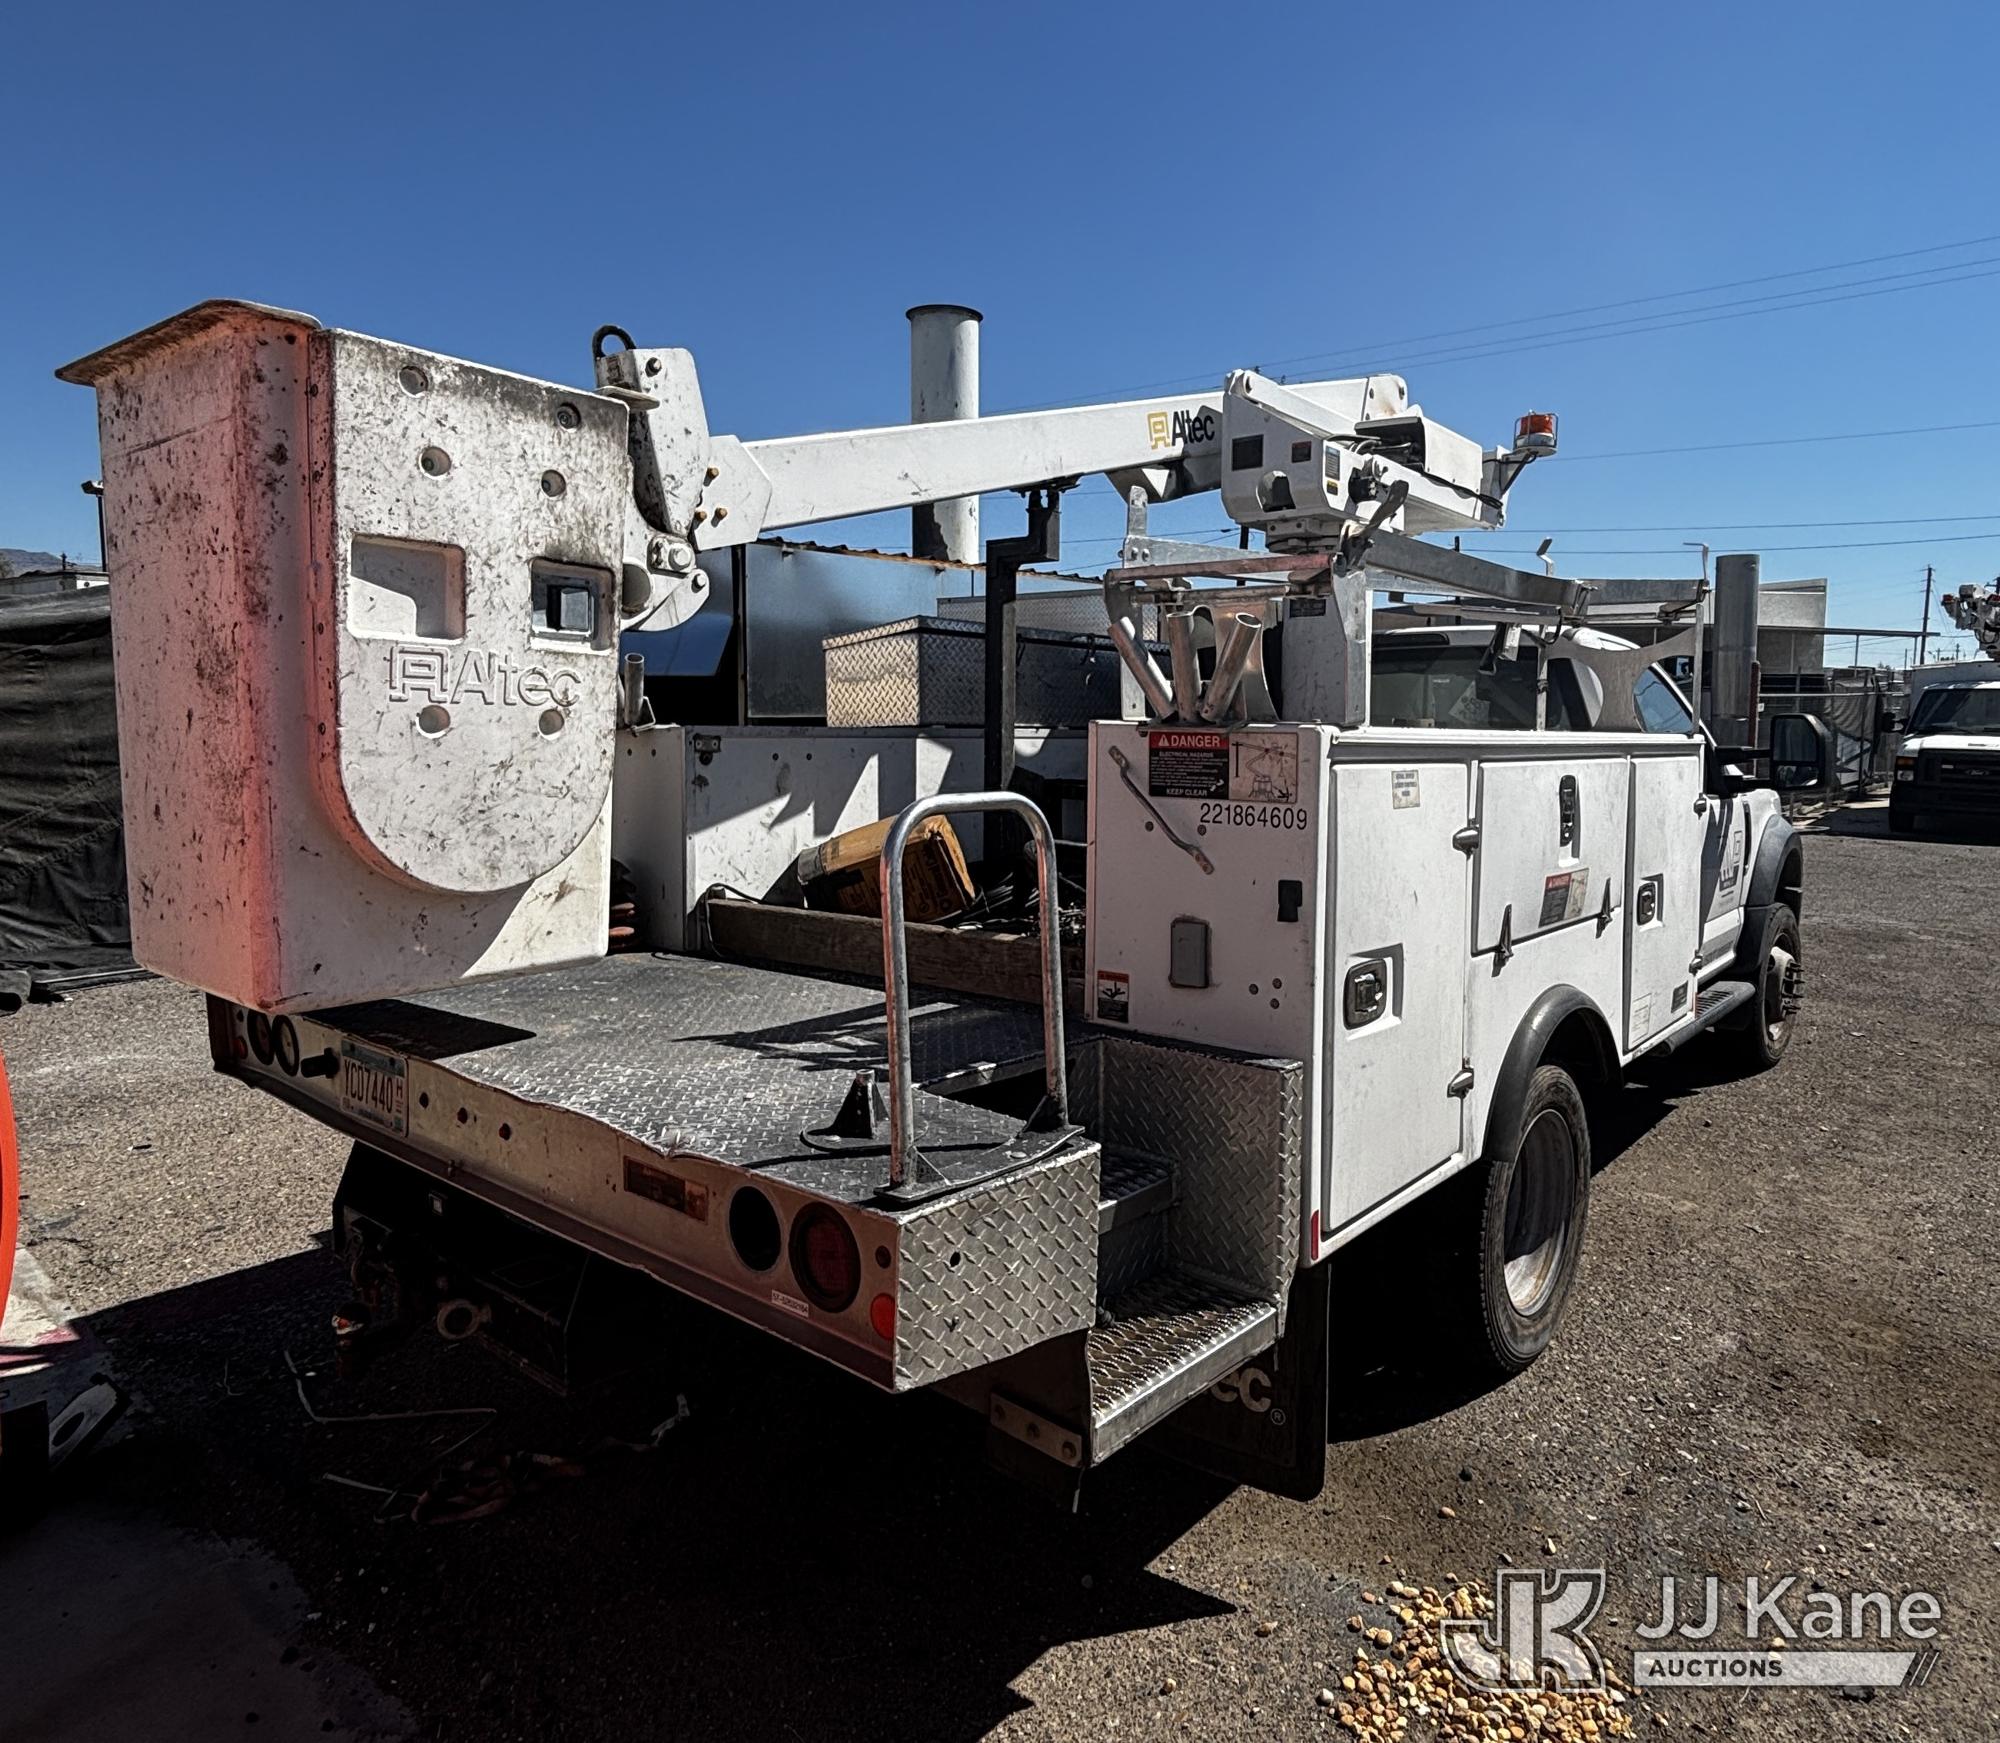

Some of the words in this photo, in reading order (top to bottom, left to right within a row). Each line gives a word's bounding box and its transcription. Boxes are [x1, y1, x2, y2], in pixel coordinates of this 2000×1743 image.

[1171, 409, 1216, 447] Altec
[449, 648, 582, 708] Altec
[1171, 735, 1220, 747] DANGER
[1166, 787, 1183, 796] KEEP
[1184, 788, 1208, 797] CLEAR
[1200, 803, 1307, 830] 221864609
